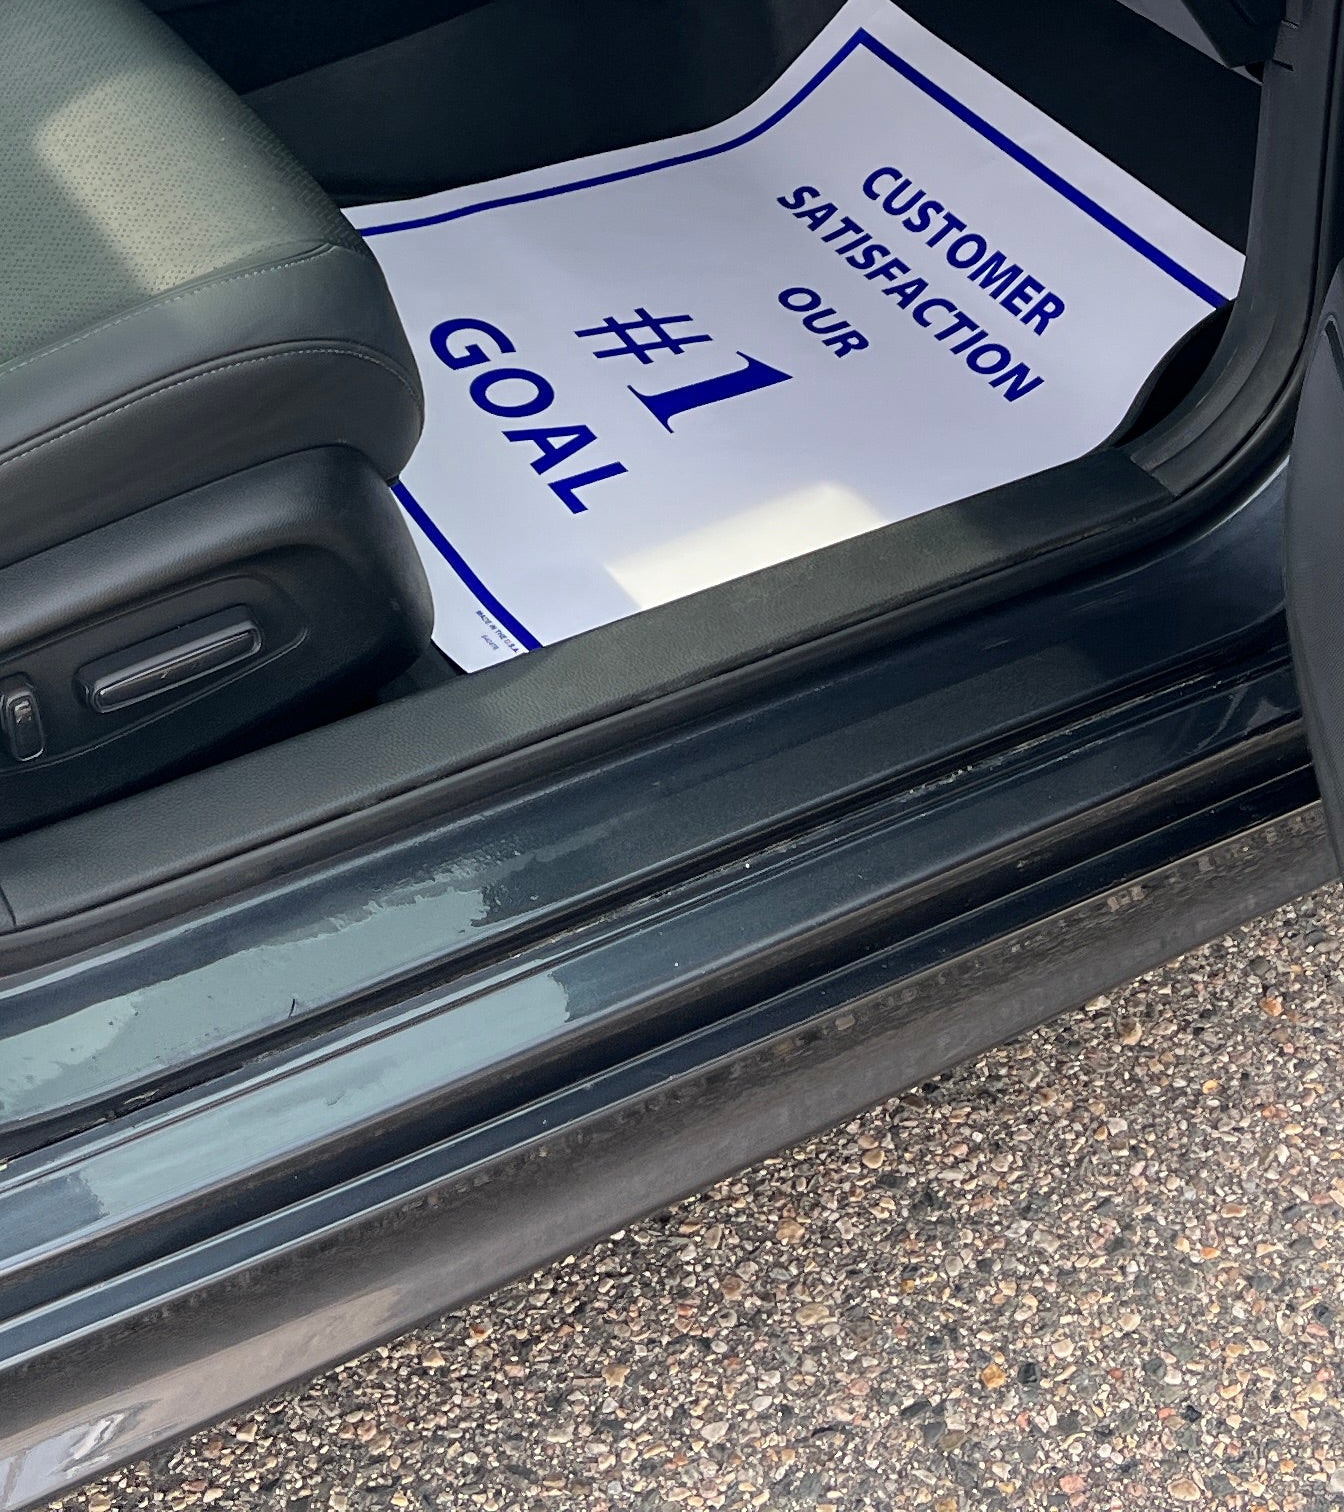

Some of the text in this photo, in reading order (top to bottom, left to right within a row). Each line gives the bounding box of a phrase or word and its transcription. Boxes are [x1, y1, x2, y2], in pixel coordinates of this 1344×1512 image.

[776, 184, 1044, 403] SATISFACTION
[777, 285, 871, 360] OUR
[860, 165, 1067, 337] CUSTOMER
[429, 316, 630, 516] GOAL
[574, 306, 794, 435] #1
